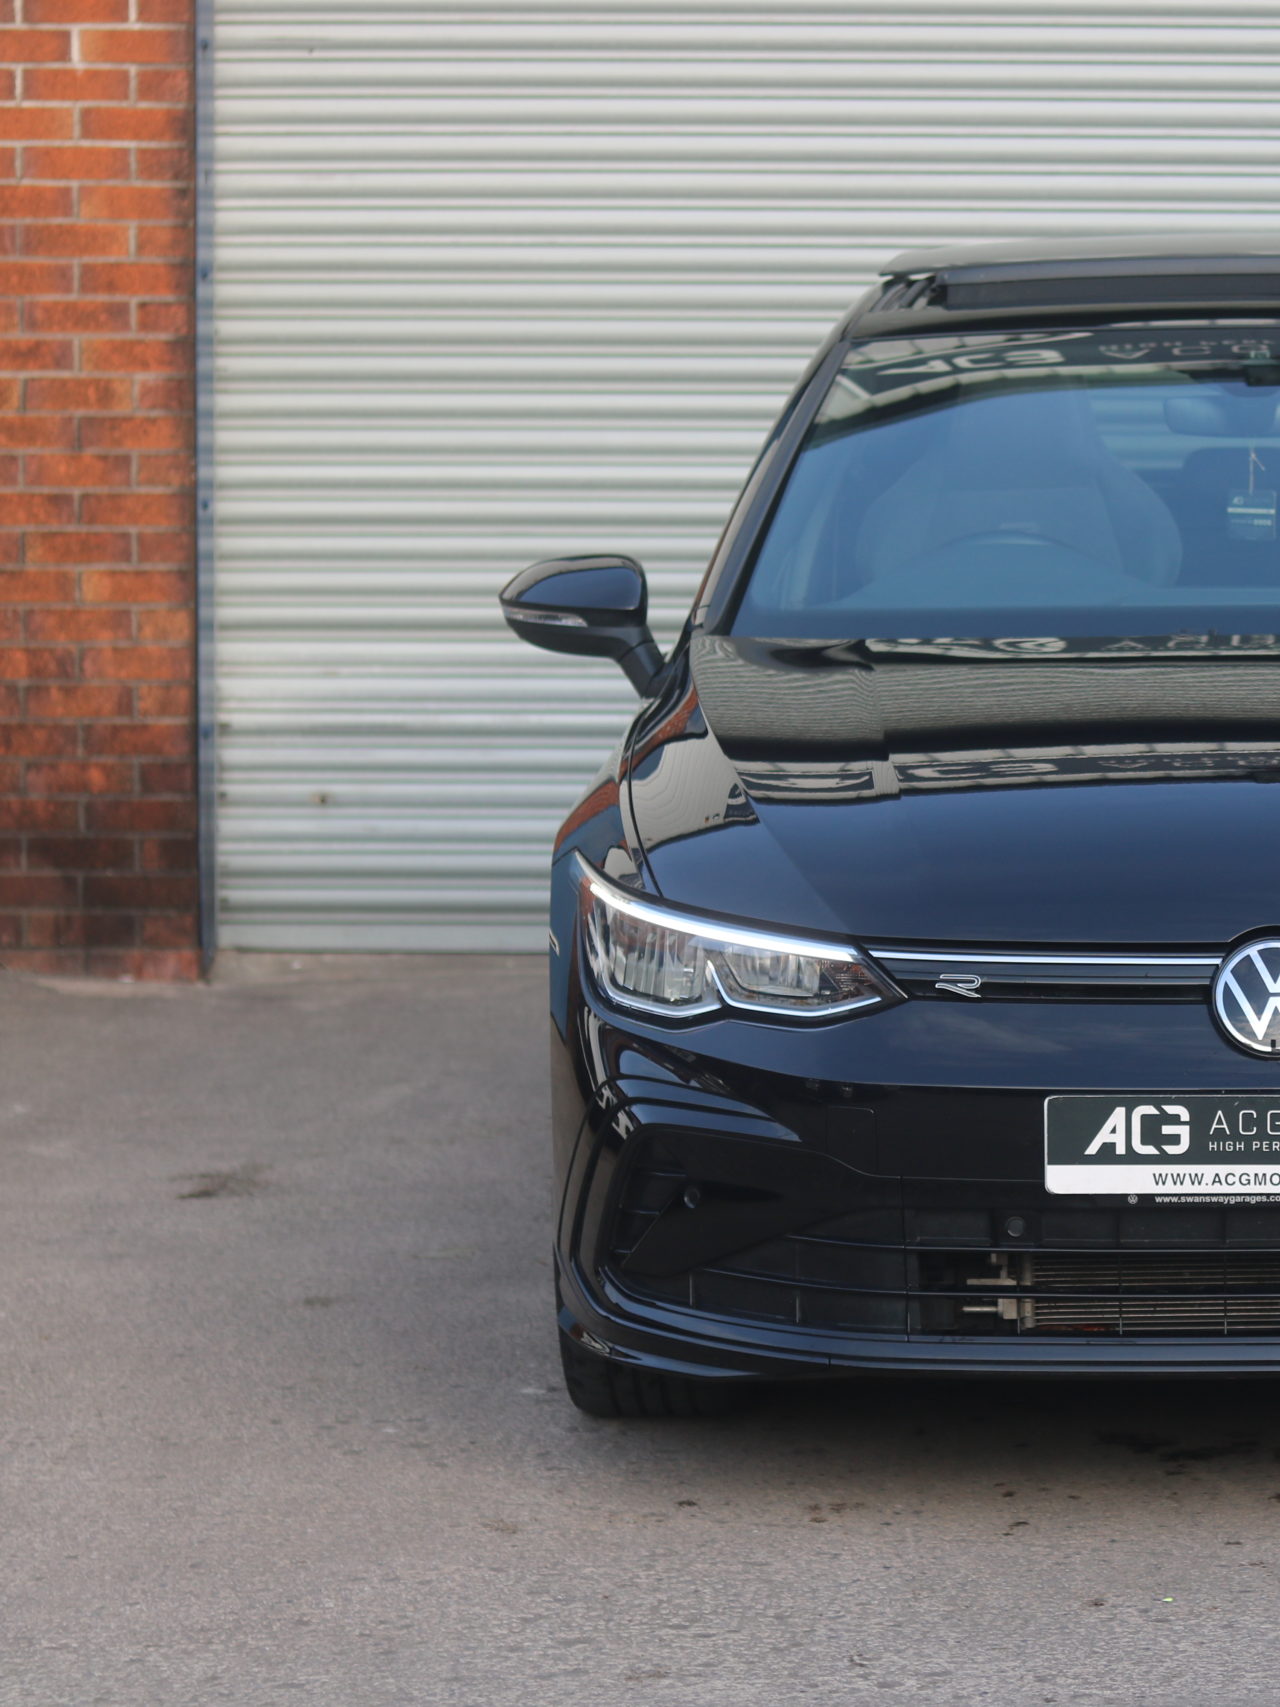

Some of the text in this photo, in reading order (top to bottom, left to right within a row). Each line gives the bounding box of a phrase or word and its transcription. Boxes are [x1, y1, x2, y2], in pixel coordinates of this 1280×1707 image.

[935, 973, 982, 998] R
[1083, 1104, 1190, 1155] ACG
[1208, 1141, 1245, 1152] HIGH
